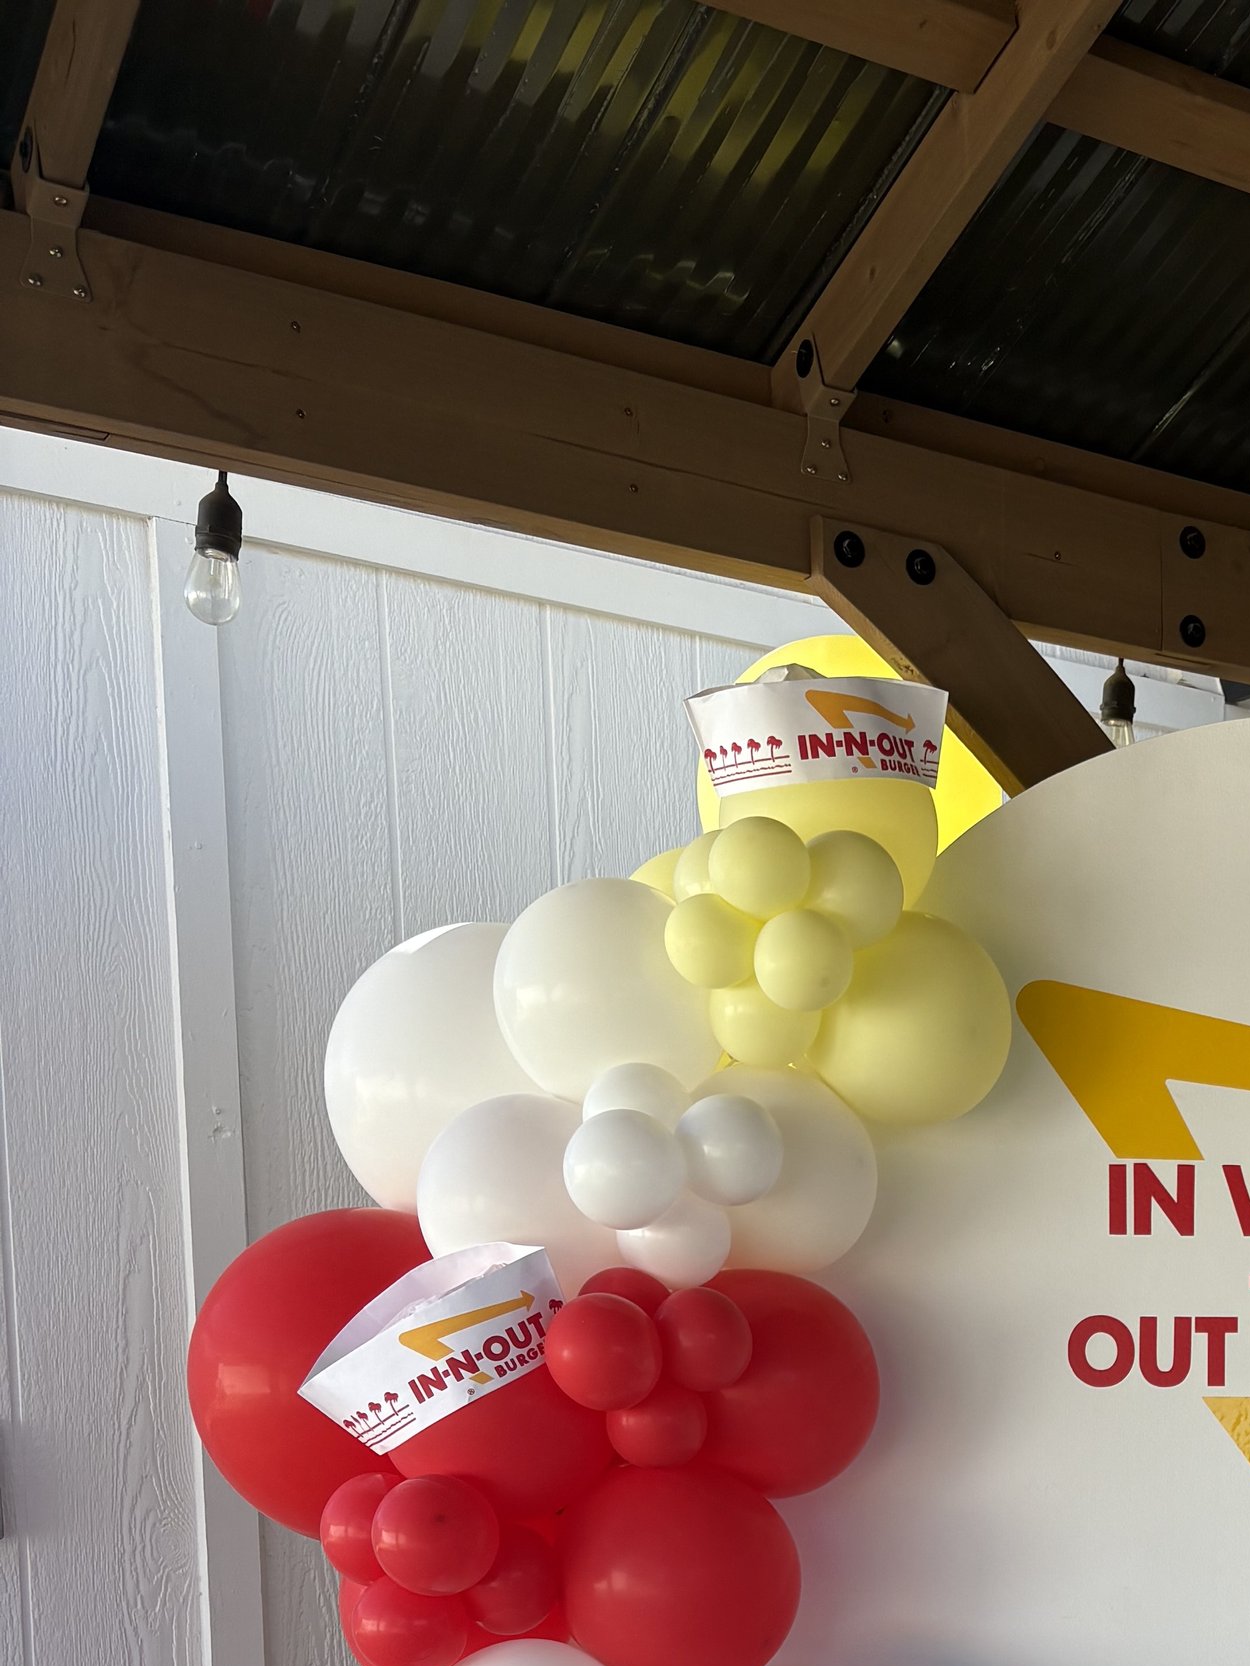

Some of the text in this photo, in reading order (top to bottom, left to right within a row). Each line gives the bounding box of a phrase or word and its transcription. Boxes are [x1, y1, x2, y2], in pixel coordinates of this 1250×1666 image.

[797, 731, 915, 763] IN-N-OUT
[1108, 1162, 1196, 1237] IN
[407, 1311, 546, 1405] IN-N-OUT
[494, 1341, 545, 1378] BURGE
[1067, 1314, 1239, 1388] OUT
